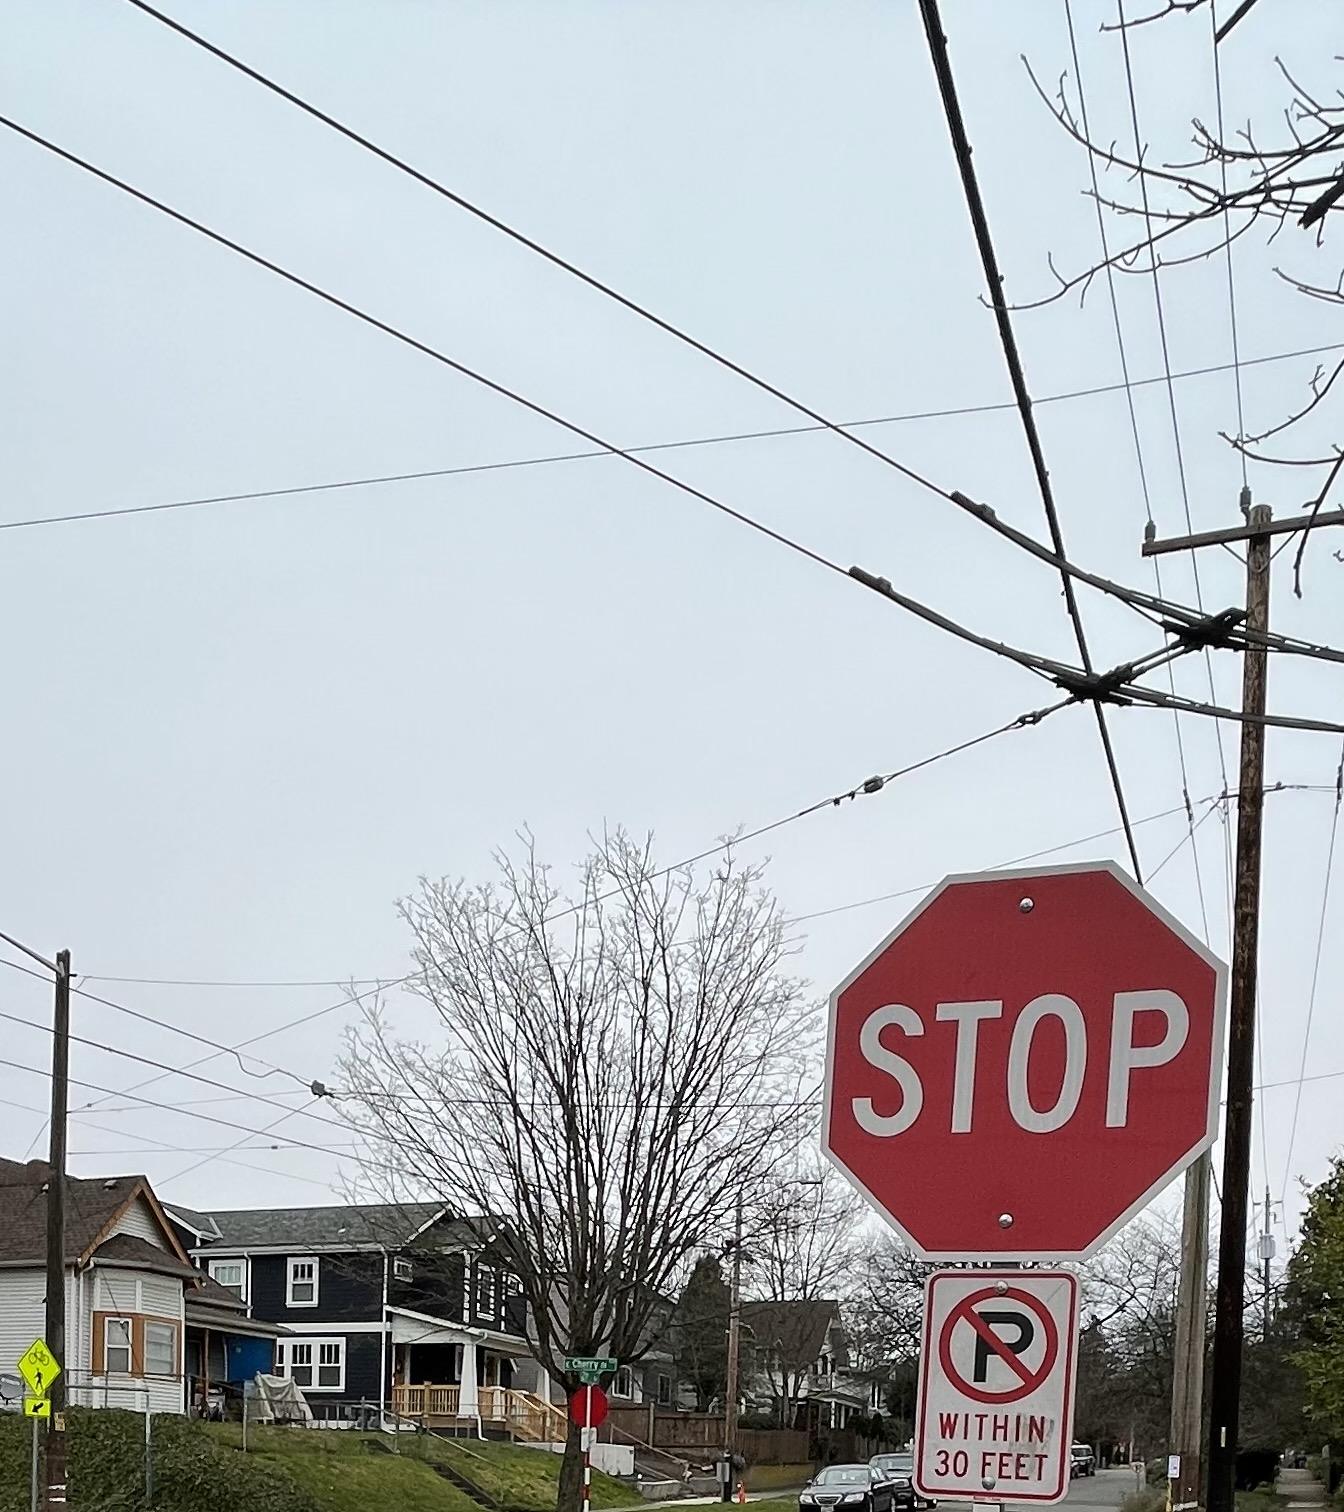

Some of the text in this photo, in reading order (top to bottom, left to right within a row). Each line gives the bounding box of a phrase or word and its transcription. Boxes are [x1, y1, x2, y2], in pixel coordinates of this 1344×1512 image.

[851, 989, 1190, 1138] STOP
[939, 1412, 1045, 1443] WITHIN
[934, 1449, 1048, 1481] 30 FEET
